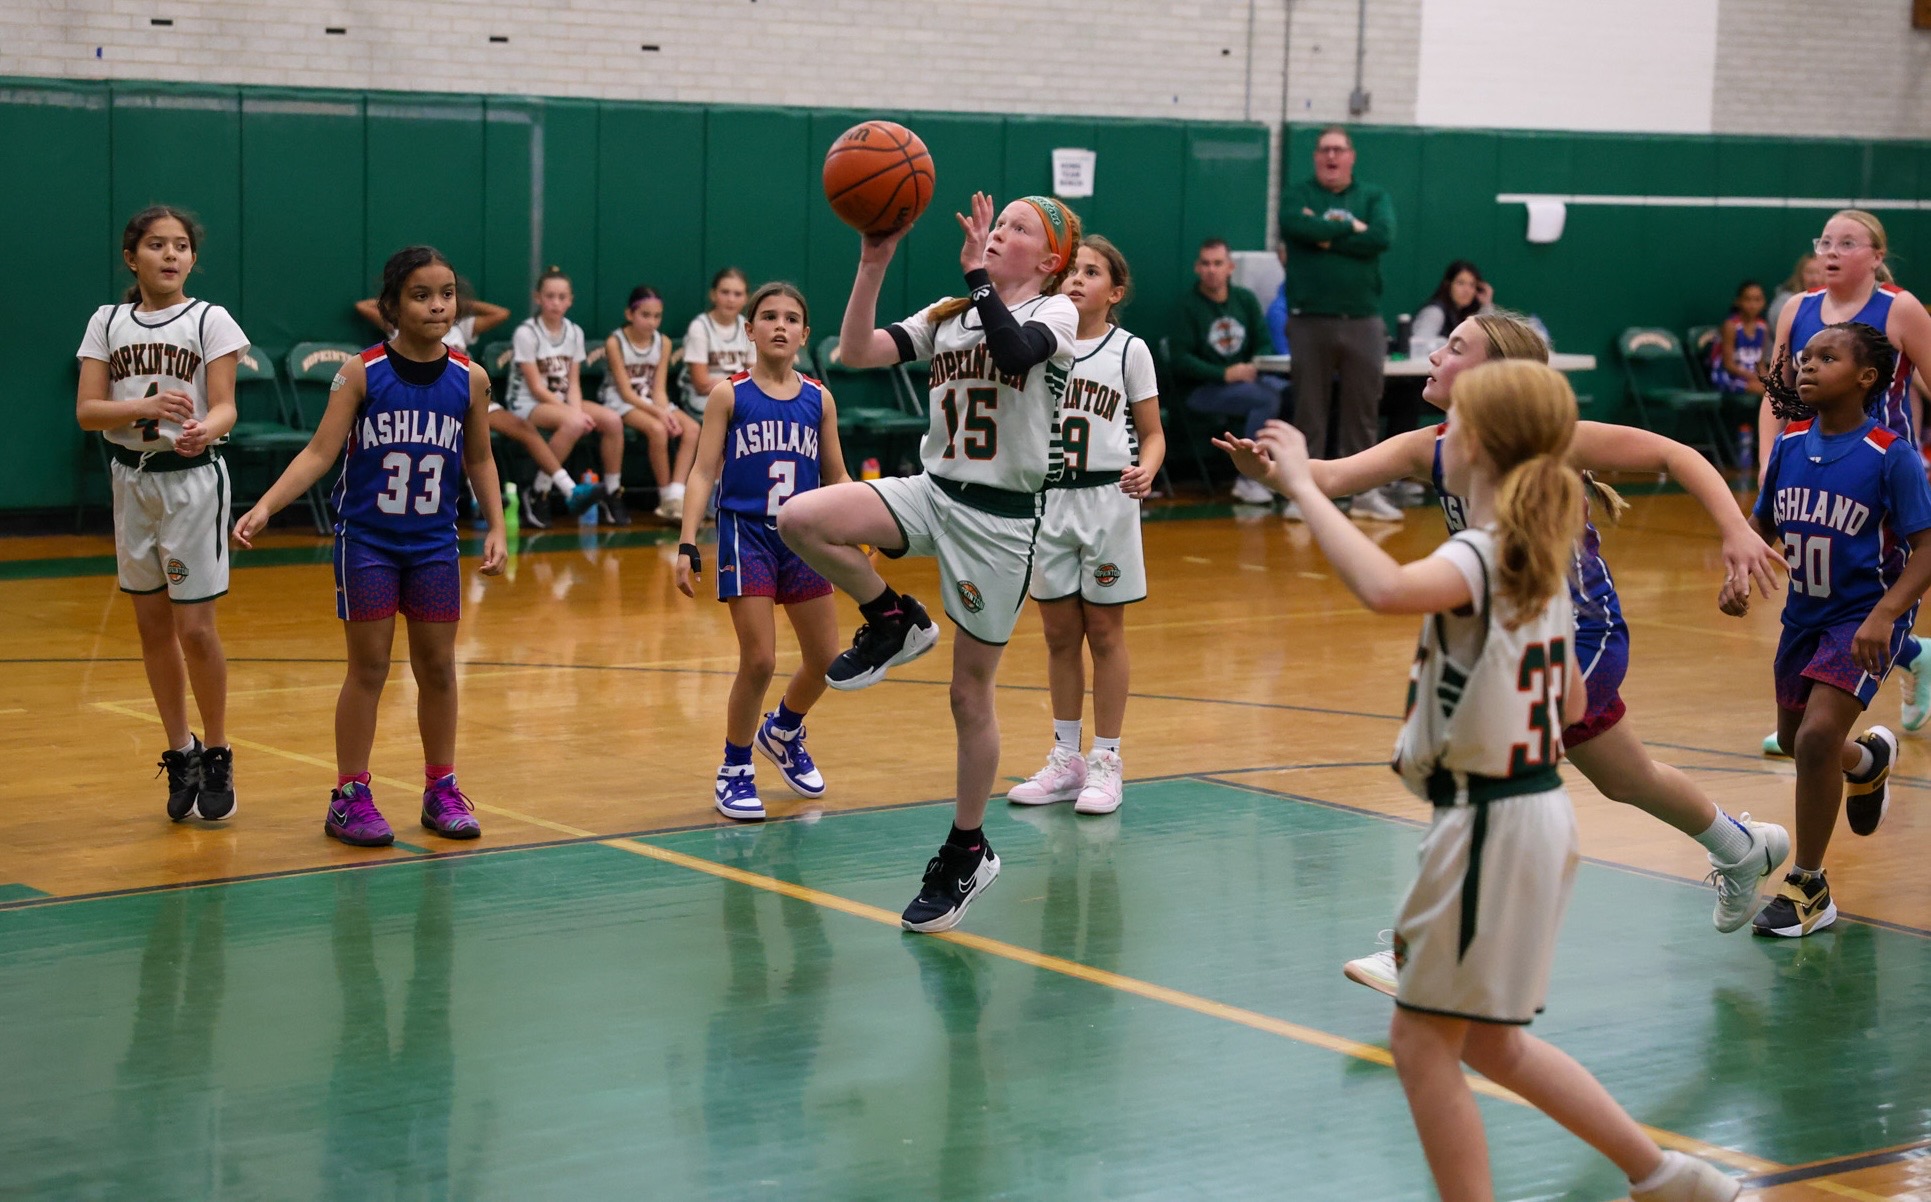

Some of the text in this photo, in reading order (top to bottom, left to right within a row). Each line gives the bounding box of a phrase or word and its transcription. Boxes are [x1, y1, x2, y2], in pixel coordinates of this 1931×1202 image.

[362, 410, 463, 453] ASHLAN
[941, 387, 998, 460] 15
[1062, 416, 1090, 471] 9
[376, 451, 445, 515] 33
[766, 460, 796, 516] 2
[1773, 487, 1870, 537] ASHLAND
[1784, 532, 1832, 598] 20
